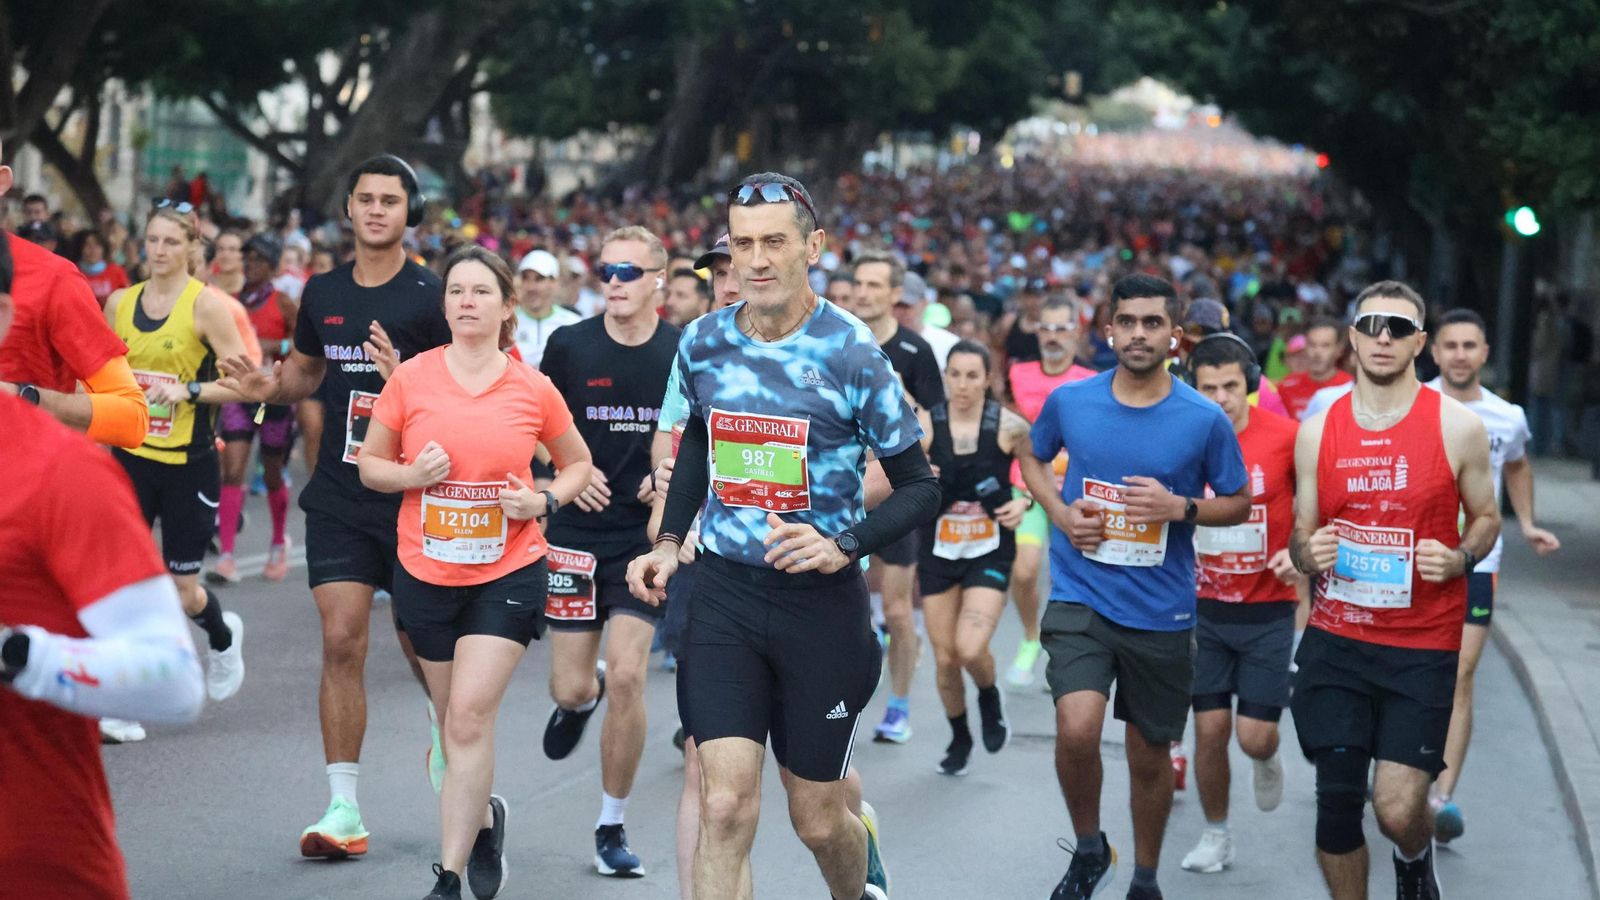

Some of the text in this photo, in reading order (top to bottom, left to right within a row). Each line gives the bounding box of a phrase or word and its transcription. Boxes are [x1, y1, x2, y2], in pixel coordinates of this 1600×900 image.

[586, 406, 635, 420] REMA
[735, 419, 800, 438] GENERALI
[741, 448, 776, 468] 987
[1347, 456, 1394, 468] GENERALI
[1347, 475, 1393, 493] MÁLAGA
[438, 510, 491, 528] 12104
[1350, 529, 1405, 545] GENERALI
[1345, 552, 1392, 573] 12576
[826, 711, 849, 720] adidas
